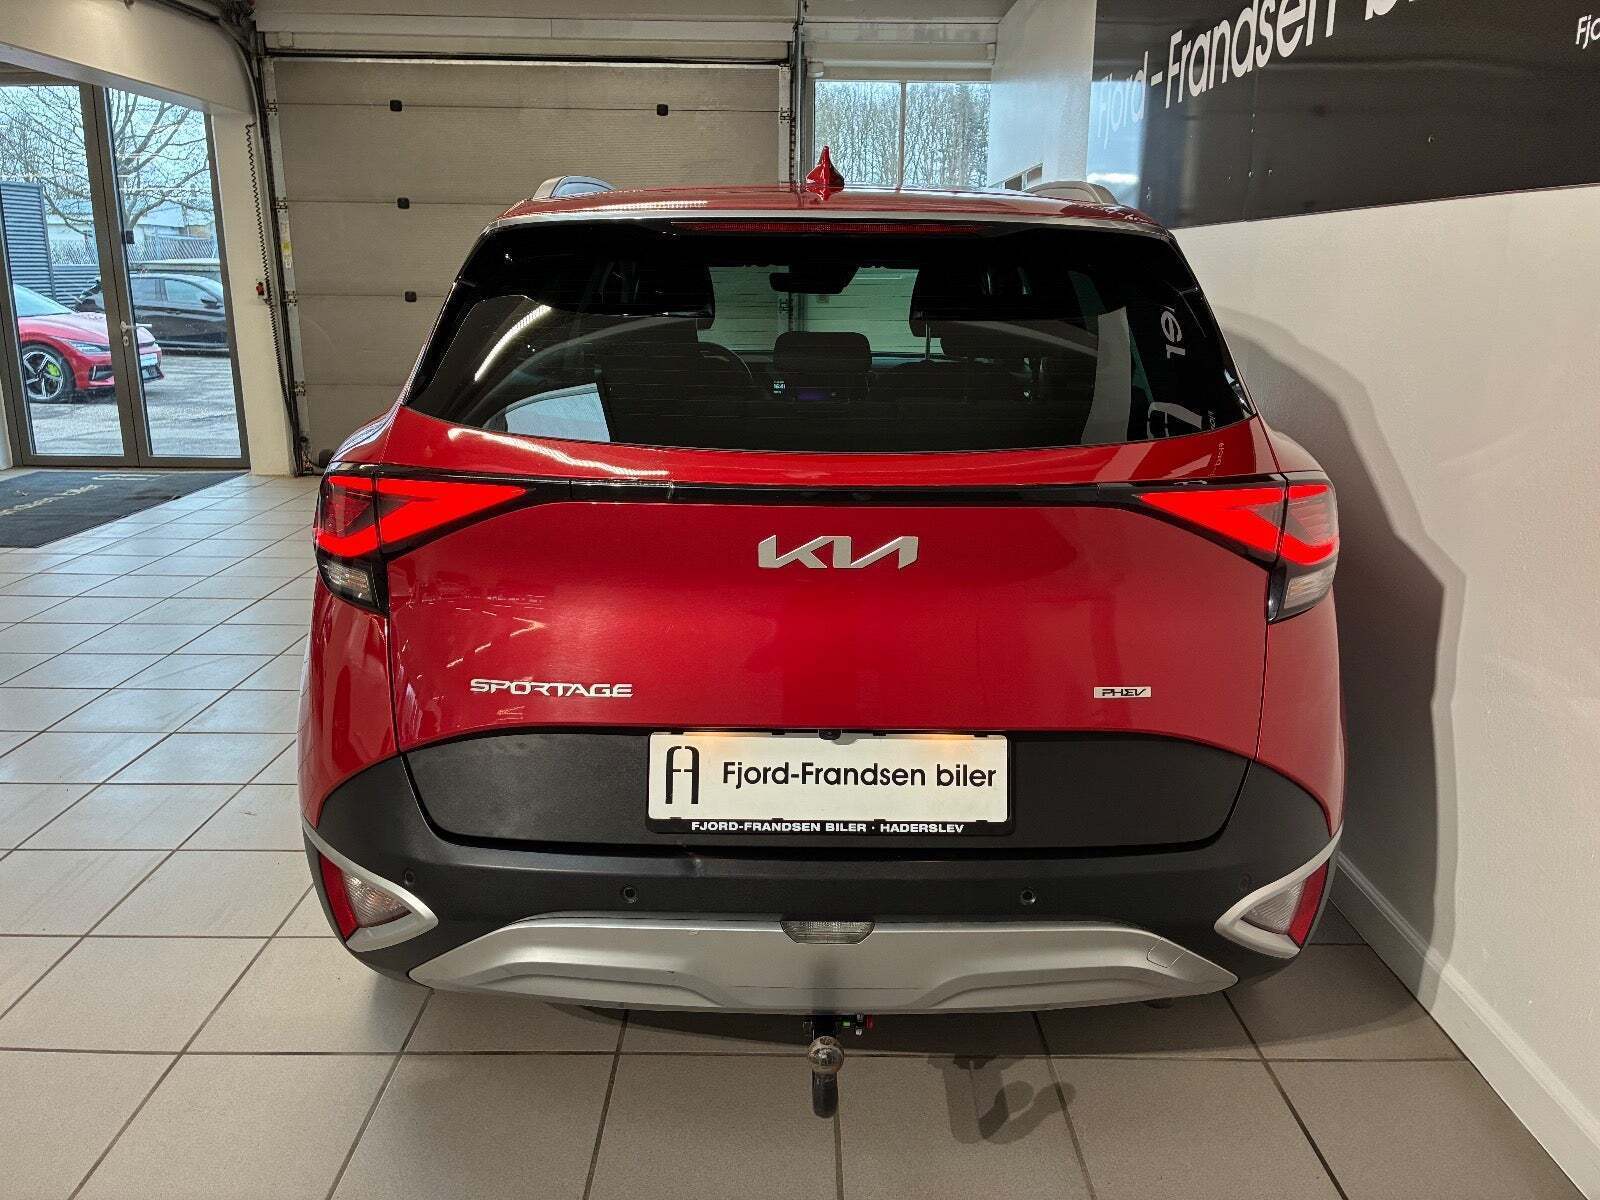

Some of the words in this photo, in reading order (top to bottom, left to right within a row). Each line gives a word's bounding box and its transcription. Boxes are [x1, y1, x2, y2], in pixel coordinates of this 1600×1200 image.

[758, 534, 919, 569] KIA
[470, 678, 634, 698] SPORTAGE
[1100, 687, 1148, 698] PHEV
[722, 761, 926, 790] Fjord-Frandsen
[935, 763, 997, 788] biler
[691, 821, 822, 833] FJORD-FRANDSEN
[825, 822, 867, 833] BILER
[879, 822, 965, 834] HADERSLEV
